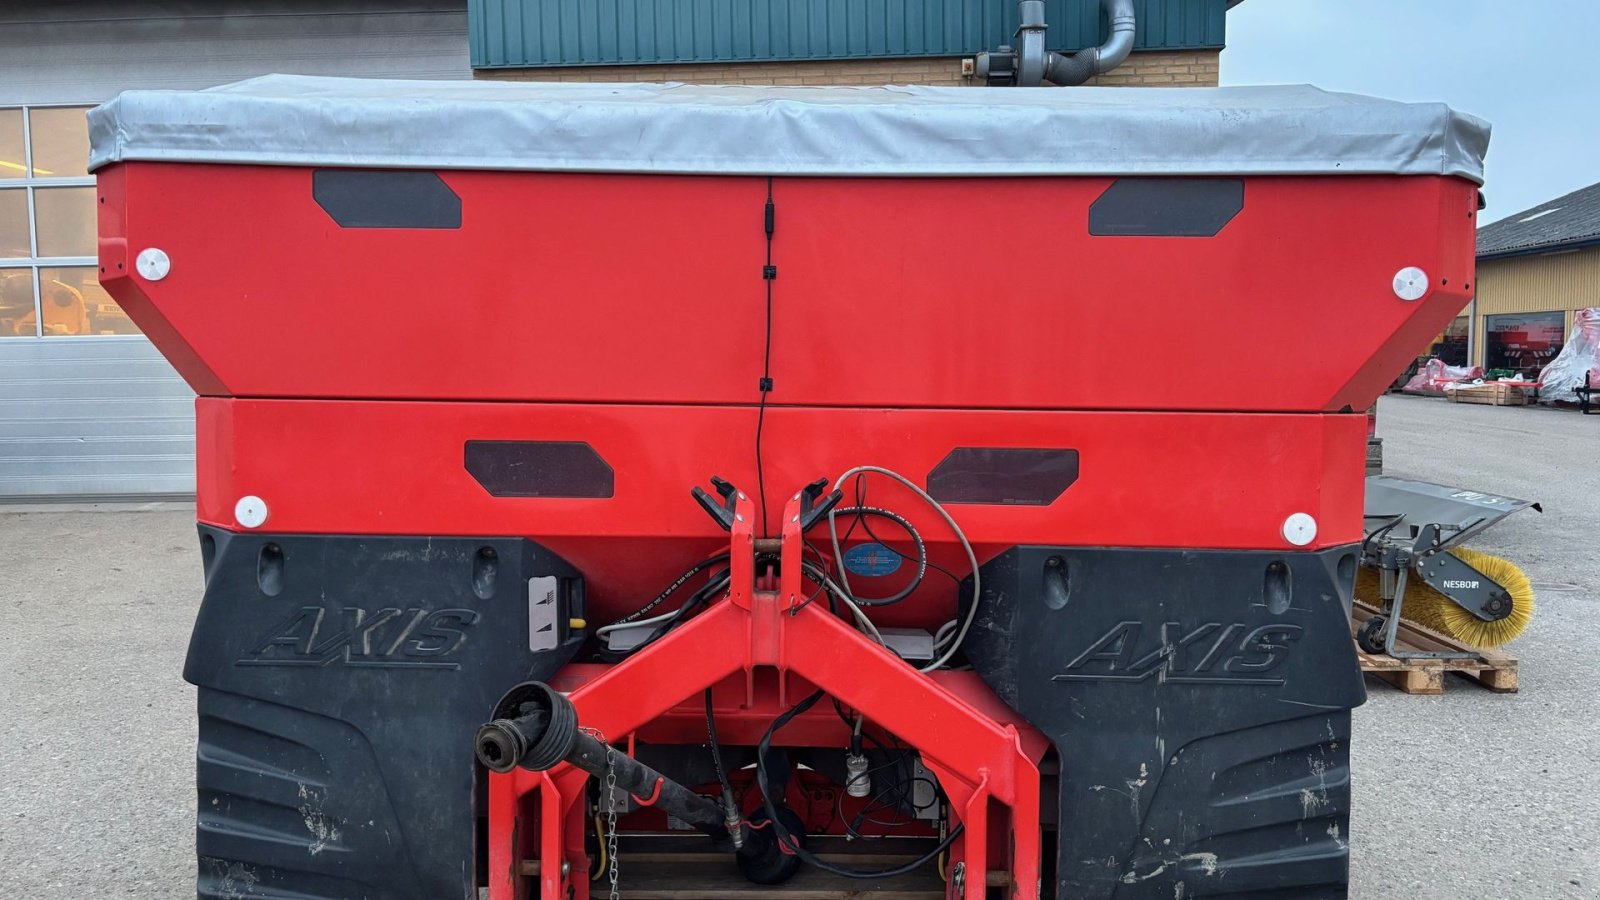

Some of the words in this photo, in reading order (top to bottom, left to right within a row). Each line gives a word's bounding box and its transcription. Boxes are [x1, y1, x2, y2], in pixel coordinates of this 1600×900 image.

[1443, 580, 1471, 589] NESBO
[250, 606, 480, 657] AXIS
[1065, 621, 1304, 673] AXIS
